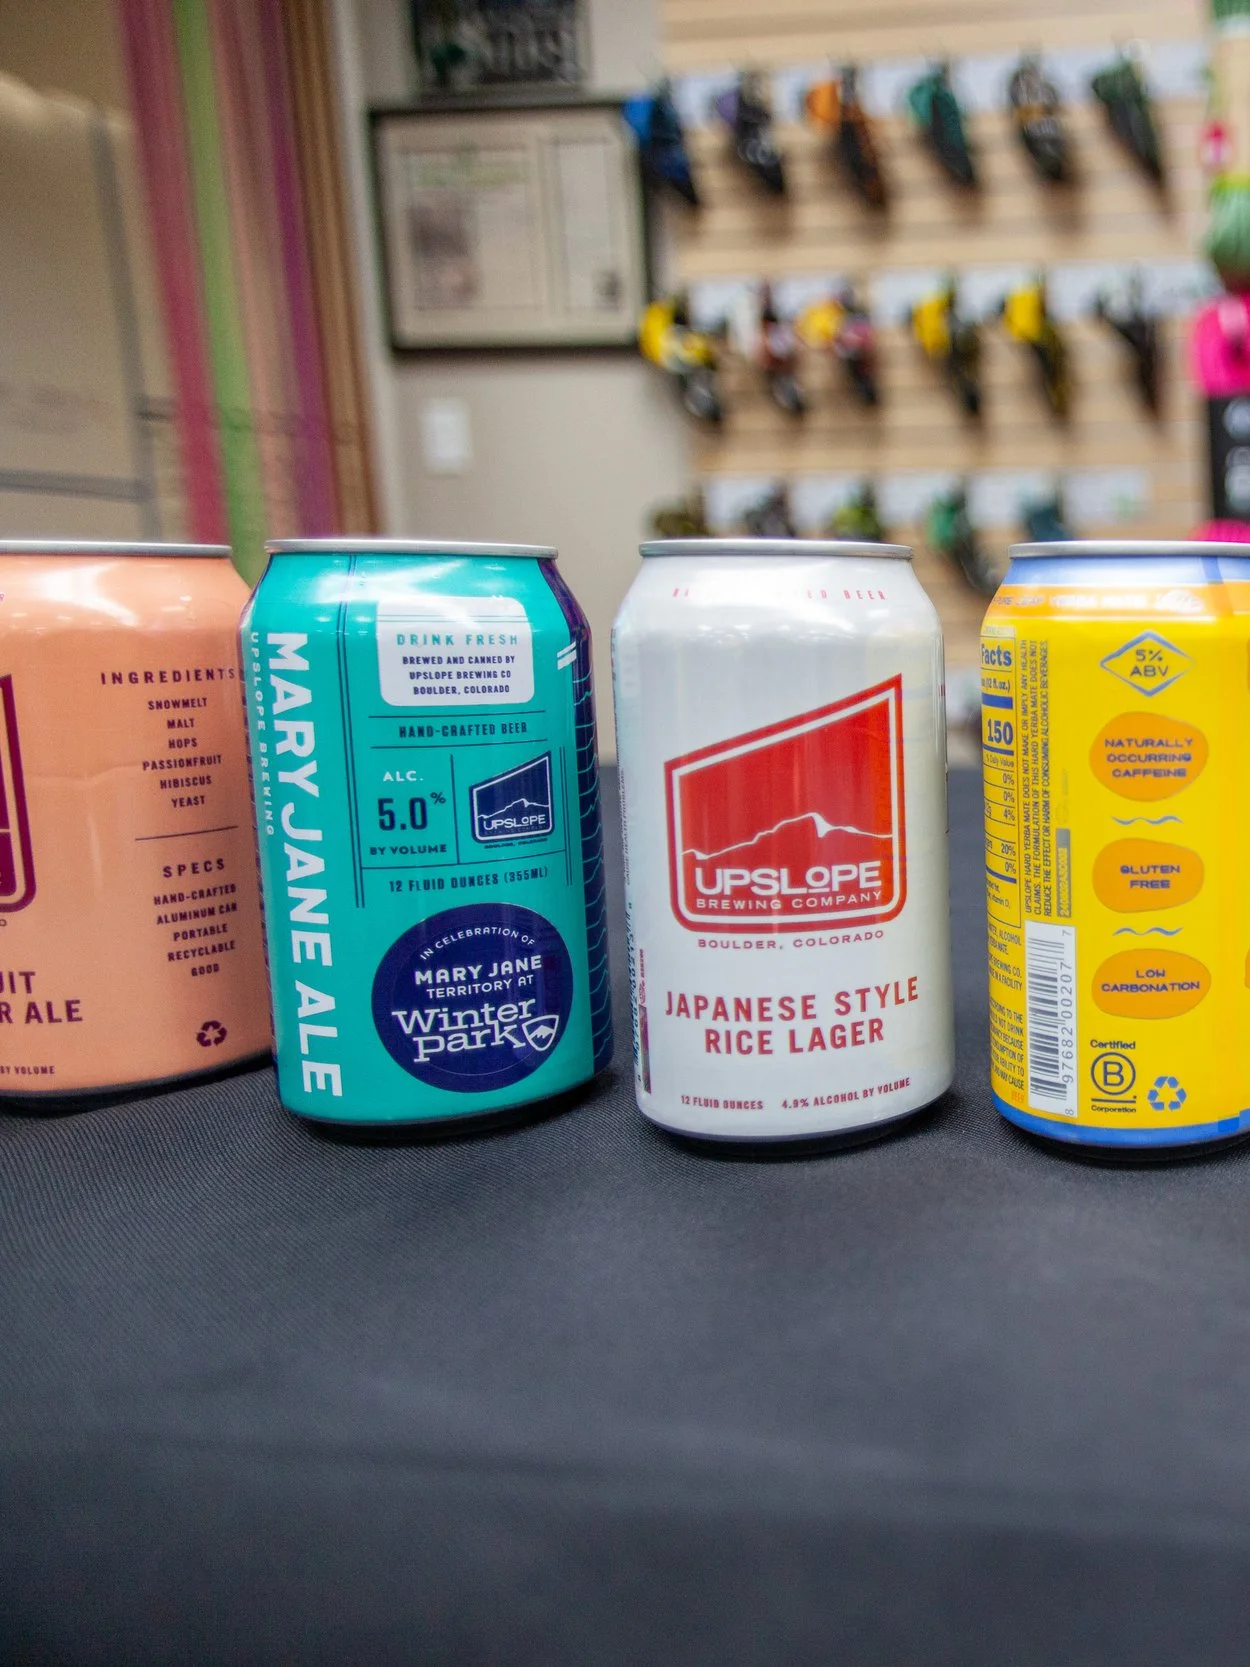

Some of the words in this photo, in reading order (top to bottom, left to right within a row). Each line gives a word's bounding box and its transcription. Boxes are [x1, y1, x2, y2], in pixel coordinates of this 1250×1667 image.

[843, 589, 885, 600] BEER
[396, 634, 454, 646] DRINK
[465, 634, 518, 645] FRESH
[402, 656, 443, 665] BREWED
[446, 656, 465, 665] AND
[468, 655, 503, 664] CANNED
[505, 655, 515, 664] BY
[1135, 649, 1163, 662] 5%
[101, 668, 235, 685] INGREDIENTS
[409, 671, 453, 680] UPSLOPE
[456, 670, 498, 680] BREWING
[500, 670, 512, 678] CO
[1130, 665, 1169, 677] ABV
[413, 686, 461, 695] BOULDER,
[464, 685, 510, 694] COLORADO
[1030, 686, 1038, 708] MATE
[148, 697, 207, 710] SNOWMELT
[267, 632, 320, 798] MARY
[1040, 692, 1048, 736] ALCOHOLIC
[167, 718, 195, 729] MALT
[399, 723, 495, 738] HAND-CRAFTED
[501, 721, 527, 735] BEER
[987, 718, 1014, 745] 150
[1021, 719, 1028, 731] OR
[1030, 710, 1038, 738] YERBA
[250, 631, 266, 731] UPSLOPE
[259, 742, 275, 836] BREWING
[168, 738, 198, 749] HOPS
[1104, 738, 1193, 748] NATURALLY
[1031, 741, 1039, 765] HARD
[1106, 753, 1192, 763] OCCURRING
[142, 755, 222, 771] PASSIONFRUIT
[1021, 759, 1029, 775] NOT
[383, 770, 424, 782] ALC.
[1002, 773, 1015, 785] 0%
[1031, 767, 1039, 785] THIS
[1112, 767, 1187, 778] CAFFEINE
[160, 775, 212, 789] HIBISCUS
[171, 795, 205, 808] YEAST
[1003, 791, 1015, 803] 0%
[1032, 788, 1039, 799] OF
[1042, 788, 1049, 799] OF
[1003, 809, 1016, 821] 4%
[1022, 801, 1030, 822] MATE
[1042, 800, 1050, 824] HARM
[483, 814, 546, 830] UPSLOPE
[1032, 801, 1041, 860] FORMULATION
[1042, 825, 1050, 837] OR
[369, 846, 385, 856] BY
[389, 843, 447, 855] VOLUME
[1000, 843, 1016, 856] 20%
[1043, 838, 1051, 867] EFFECT
[162, 858, 225, 878] SPECS
[1004, 861, 1017, 875] 0%
[1023, 853, 1031, 876] HARD
[1033, 864, 1041, 879] THE
[1120, 864, 1181, 874] GLUTEN
[389, 880, 403, 893] 12
[408, 878, 445, 892] FLUID
[451, 873, 499, 889] OUNCES
[504, 866, 548, 884] (355ML)
[695, 860, 883, 897] UPSLOPE
[1043, 868, 1051, 883] THE
[280, 802, 333, 967] JANE
[1130, 879, 1171, 889] FREE
[154, 883, 236, 906] HAND-CRAFTED
[696, 897, 783, 911] BREWING
[791, 890, 882, 909] COMPANY
[1024, 878, 1032, 914] UPSLOPE
[1043, 885, 1052, 917] REDUCE
[156, 906, 216, 925] ALUMINUM
[218, 902, 238, 915] CAN
[173, 923, 228, 942] PORTABLE
[698, 938, 784, 951] BOULDER,
[792, 929, 884, 949] COLORADO
[1062, 929, 1072, 938] 7
[167, 939, 236, 962] RECYCLABLE
[420, 948, 434, 960] IN
[435, 926, 520, 949] CELEBRATION
[521, 935, 535, 946] OF
[191, 963, 219, 977] GOOD
[415, 964, 483, 985] MARY
[488, 955, 542, 978] JANE
[1136, 968, 1166, 978] LOW
[426, 978, 512, 999] TERRITORY
[518, 974, 534, 987] AT
[1060, 962, 1073, 1020] 00207
[1101, 980, 1200, 993] CARBONATION
[665, 991, 817, 1023] JAPANESE
[834, 975, 919, 1016] STYLE
[25, 999, 83, 1024] ALE
[391, 998, 536, 1035] Winter
[295, 980, 343, 1097] ALE
[704, 1028, 774, 1056] RICE
[788, 1017, 884, 1054] LAGER
[1090, 1039, 1136, 1049] Certified
[1061, 1027, 1074, 1084] 97682
[14, 1065, 55, 1075] VOLUME
[1103, 1061, 1125, 1086] B
[782, 1097, 809, 1110] 4.9%
[813, 1090, 860, 1107] ALCOHOL
[862, 1087, 875, 1100] BY
[877, 1077, 911, 1096] VOLUME
[680, 1094, 691, 1106] 12
[693, 1096, 719, 1109] FLUID
[723, 1099, 764, 1110] OUNCES
[1091, 1104, 1137, 1114] Corporation
